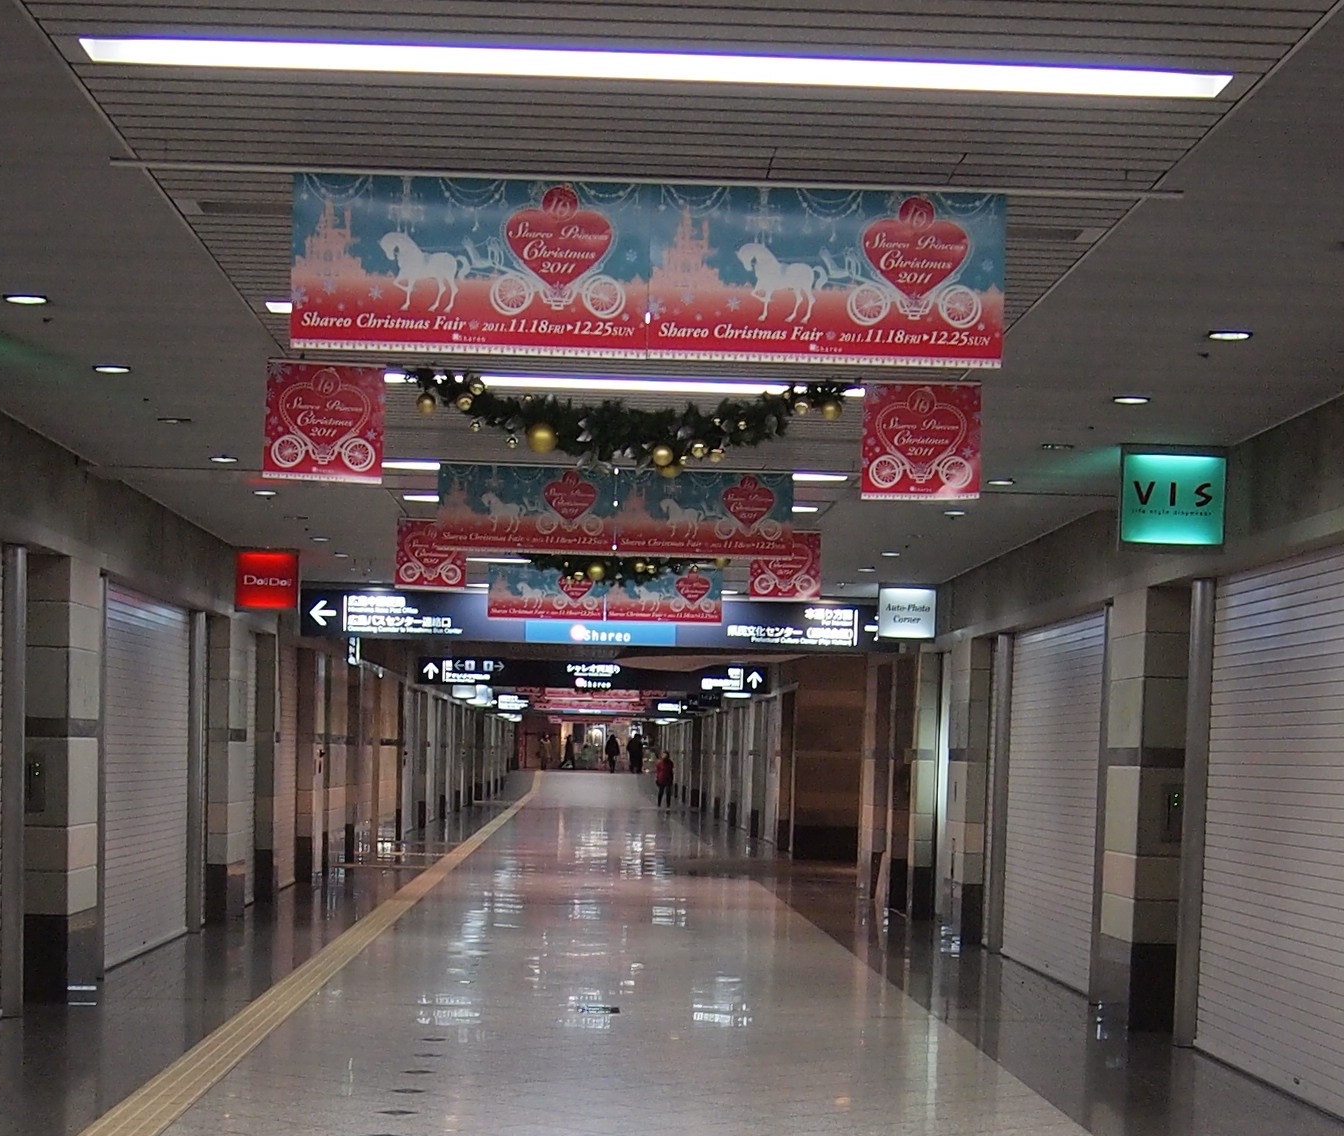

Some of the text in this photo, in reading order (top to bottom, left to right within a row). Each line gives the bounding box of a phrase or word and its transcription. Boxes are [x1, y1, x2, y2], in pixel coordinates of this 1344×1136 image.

[523, 240, 595, 261] Christmas
[879, 249, 953, 271] Christmas
[539, 261, 576, 274] 2011
[896, 272, 934, 284] 2011
[301, 311, 352, 328] Shareo
[356, 312, 431, 330] Christmas
[434, 314, 467, 331] Fair
[658, 322, 709, 339] Shareo
[714, 324, 787, 341] Christmas
[791, 326, 823, 342] Fair
[297, 411, 352, 427] Christmas
[309, 427, 337, 437] 2011
[894, 430, 949, 446] Christmas
[906, 447, 935, 456] 2011
[1133, 481, 1213, 507] VIS
[886, 603, 931, 612] Auto-Photo
[893, 614, 921, 624] Corner
[584, 629, 631, 642] Shareo
